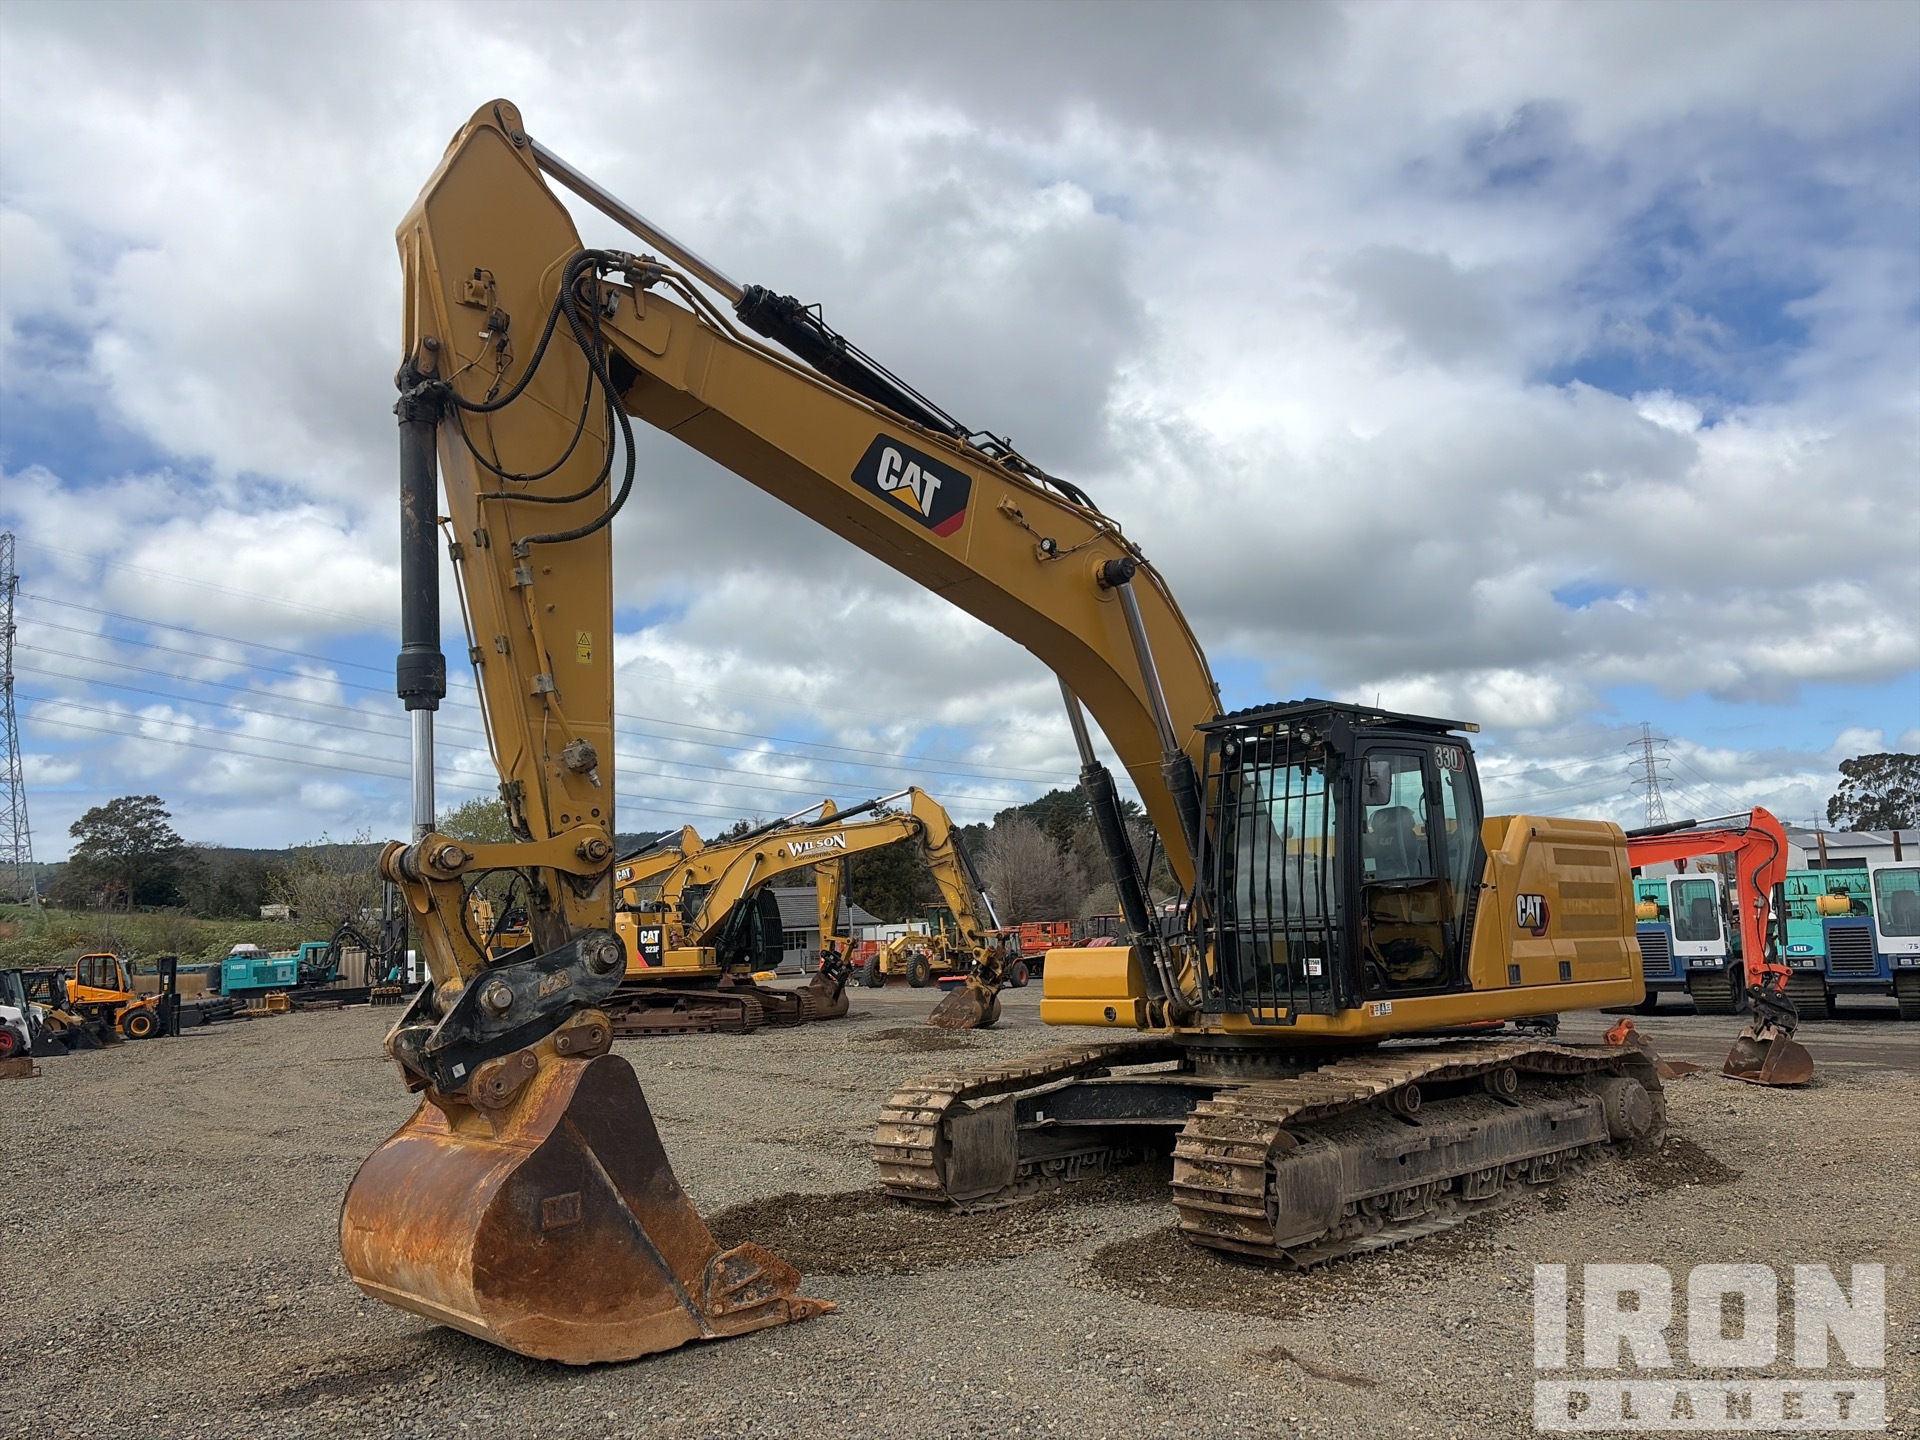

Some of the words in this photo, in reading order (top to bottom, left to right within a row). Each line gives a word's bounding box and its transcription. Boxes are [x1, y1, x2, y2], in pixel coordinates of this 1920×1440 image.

[877, 446, 942, 518] CAT
[1435, 745, 1457, 768] 330
[786, 831, 847, 857] WILSON
[616, 867, 631, 881] CAT
[1516, 894, 1542, 927] CAT
[640, 930, 660, 944] CAT
[645, 945, 660, 953] 323F
